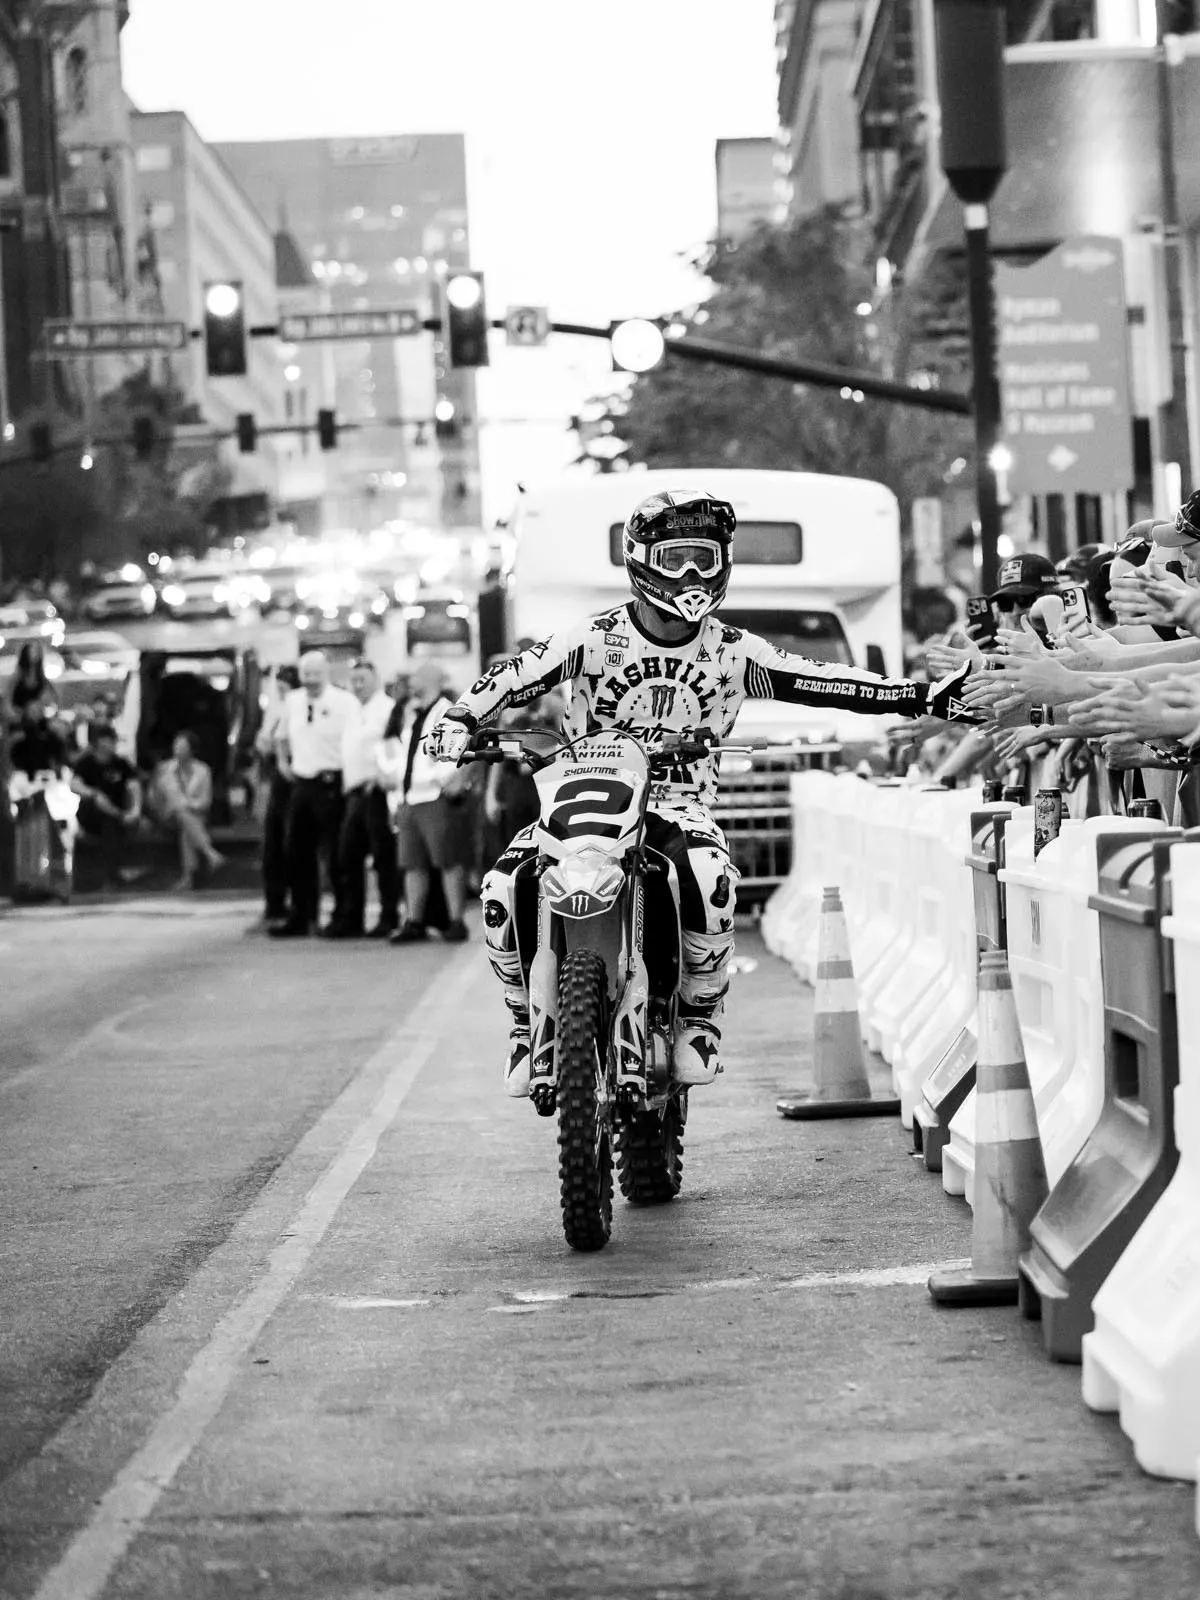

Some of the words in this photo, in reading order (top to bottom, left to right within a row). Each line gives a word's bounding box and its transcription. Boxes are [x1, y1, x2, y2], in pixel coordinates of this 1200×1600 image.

[607, 652, 622, 666] 101
[794, 678, 856, 696] REMINDER
[859, 686, 874, 698] TO
[548, 778, 634, 841] 2
